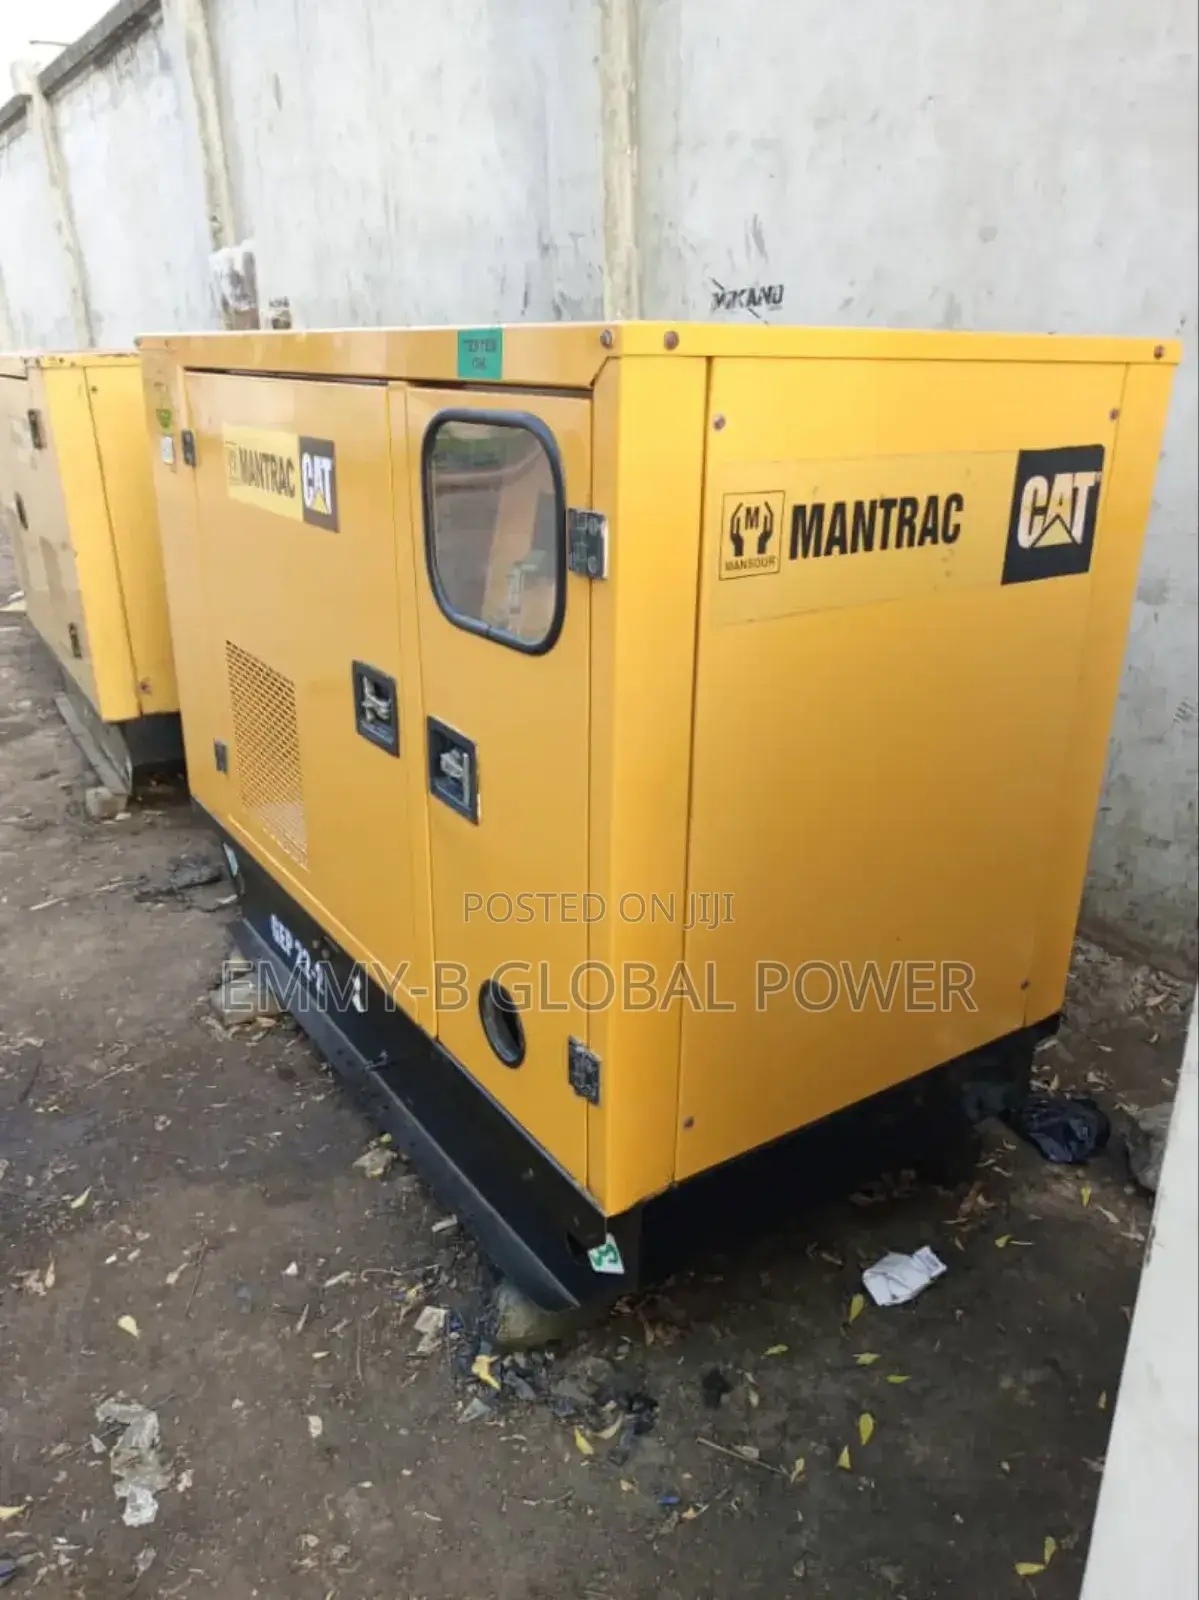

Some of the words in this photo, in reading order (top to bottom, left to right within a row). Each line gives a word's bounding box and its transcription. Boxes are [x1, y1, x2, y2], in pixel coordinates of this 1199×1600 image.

[302, 452, 333, 515] CAT
[788, 493, 964, 560] MANTRAC
[1017, 471, 1097, 549] CAT
